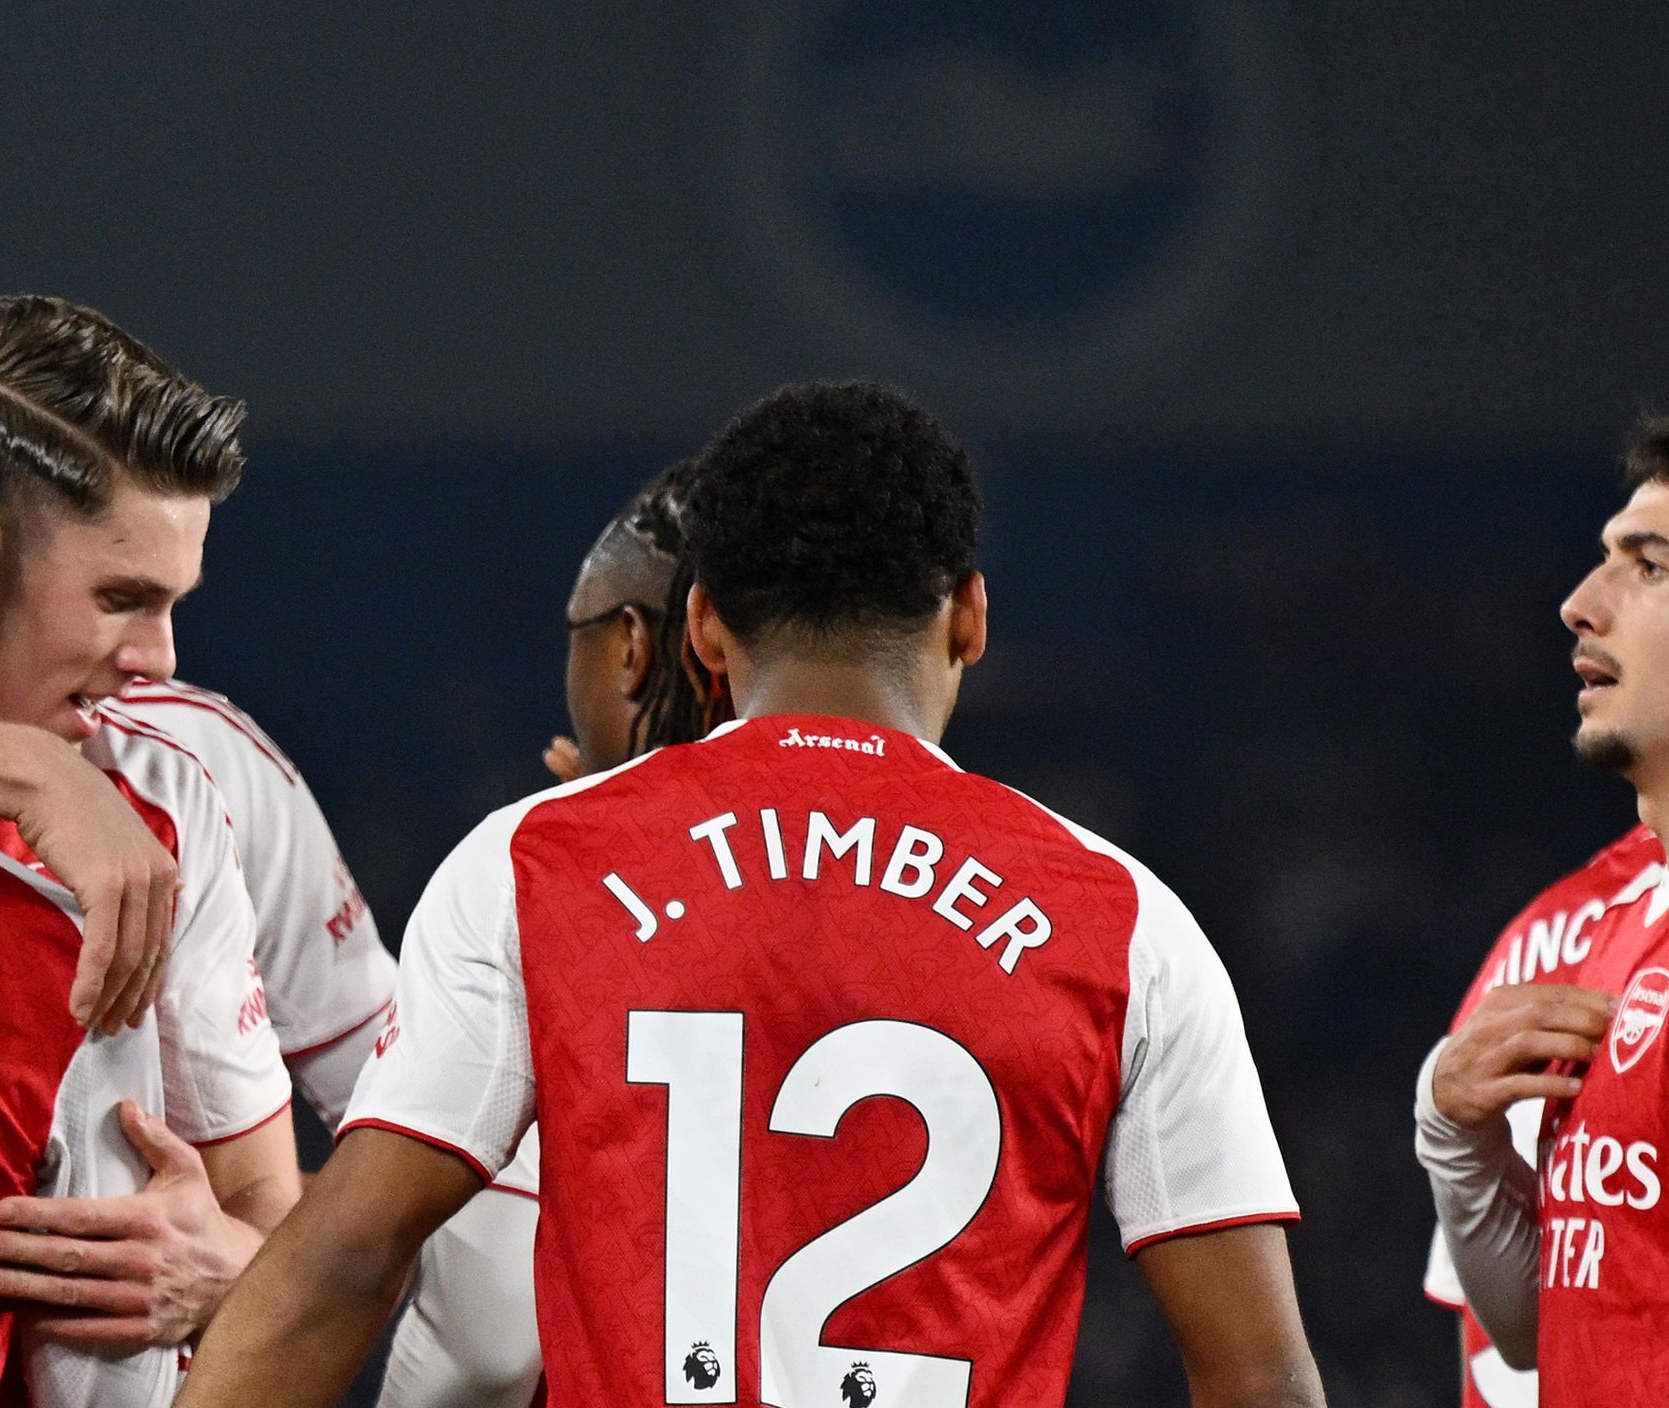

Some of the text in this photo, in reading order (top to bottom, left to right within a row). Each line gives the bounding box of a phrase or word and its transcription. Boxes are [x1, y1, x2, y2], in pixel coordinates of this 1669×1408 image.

[779, 728, 886, 757] Arsenal
[602, 808, 1053, 975] J. TIMBER
